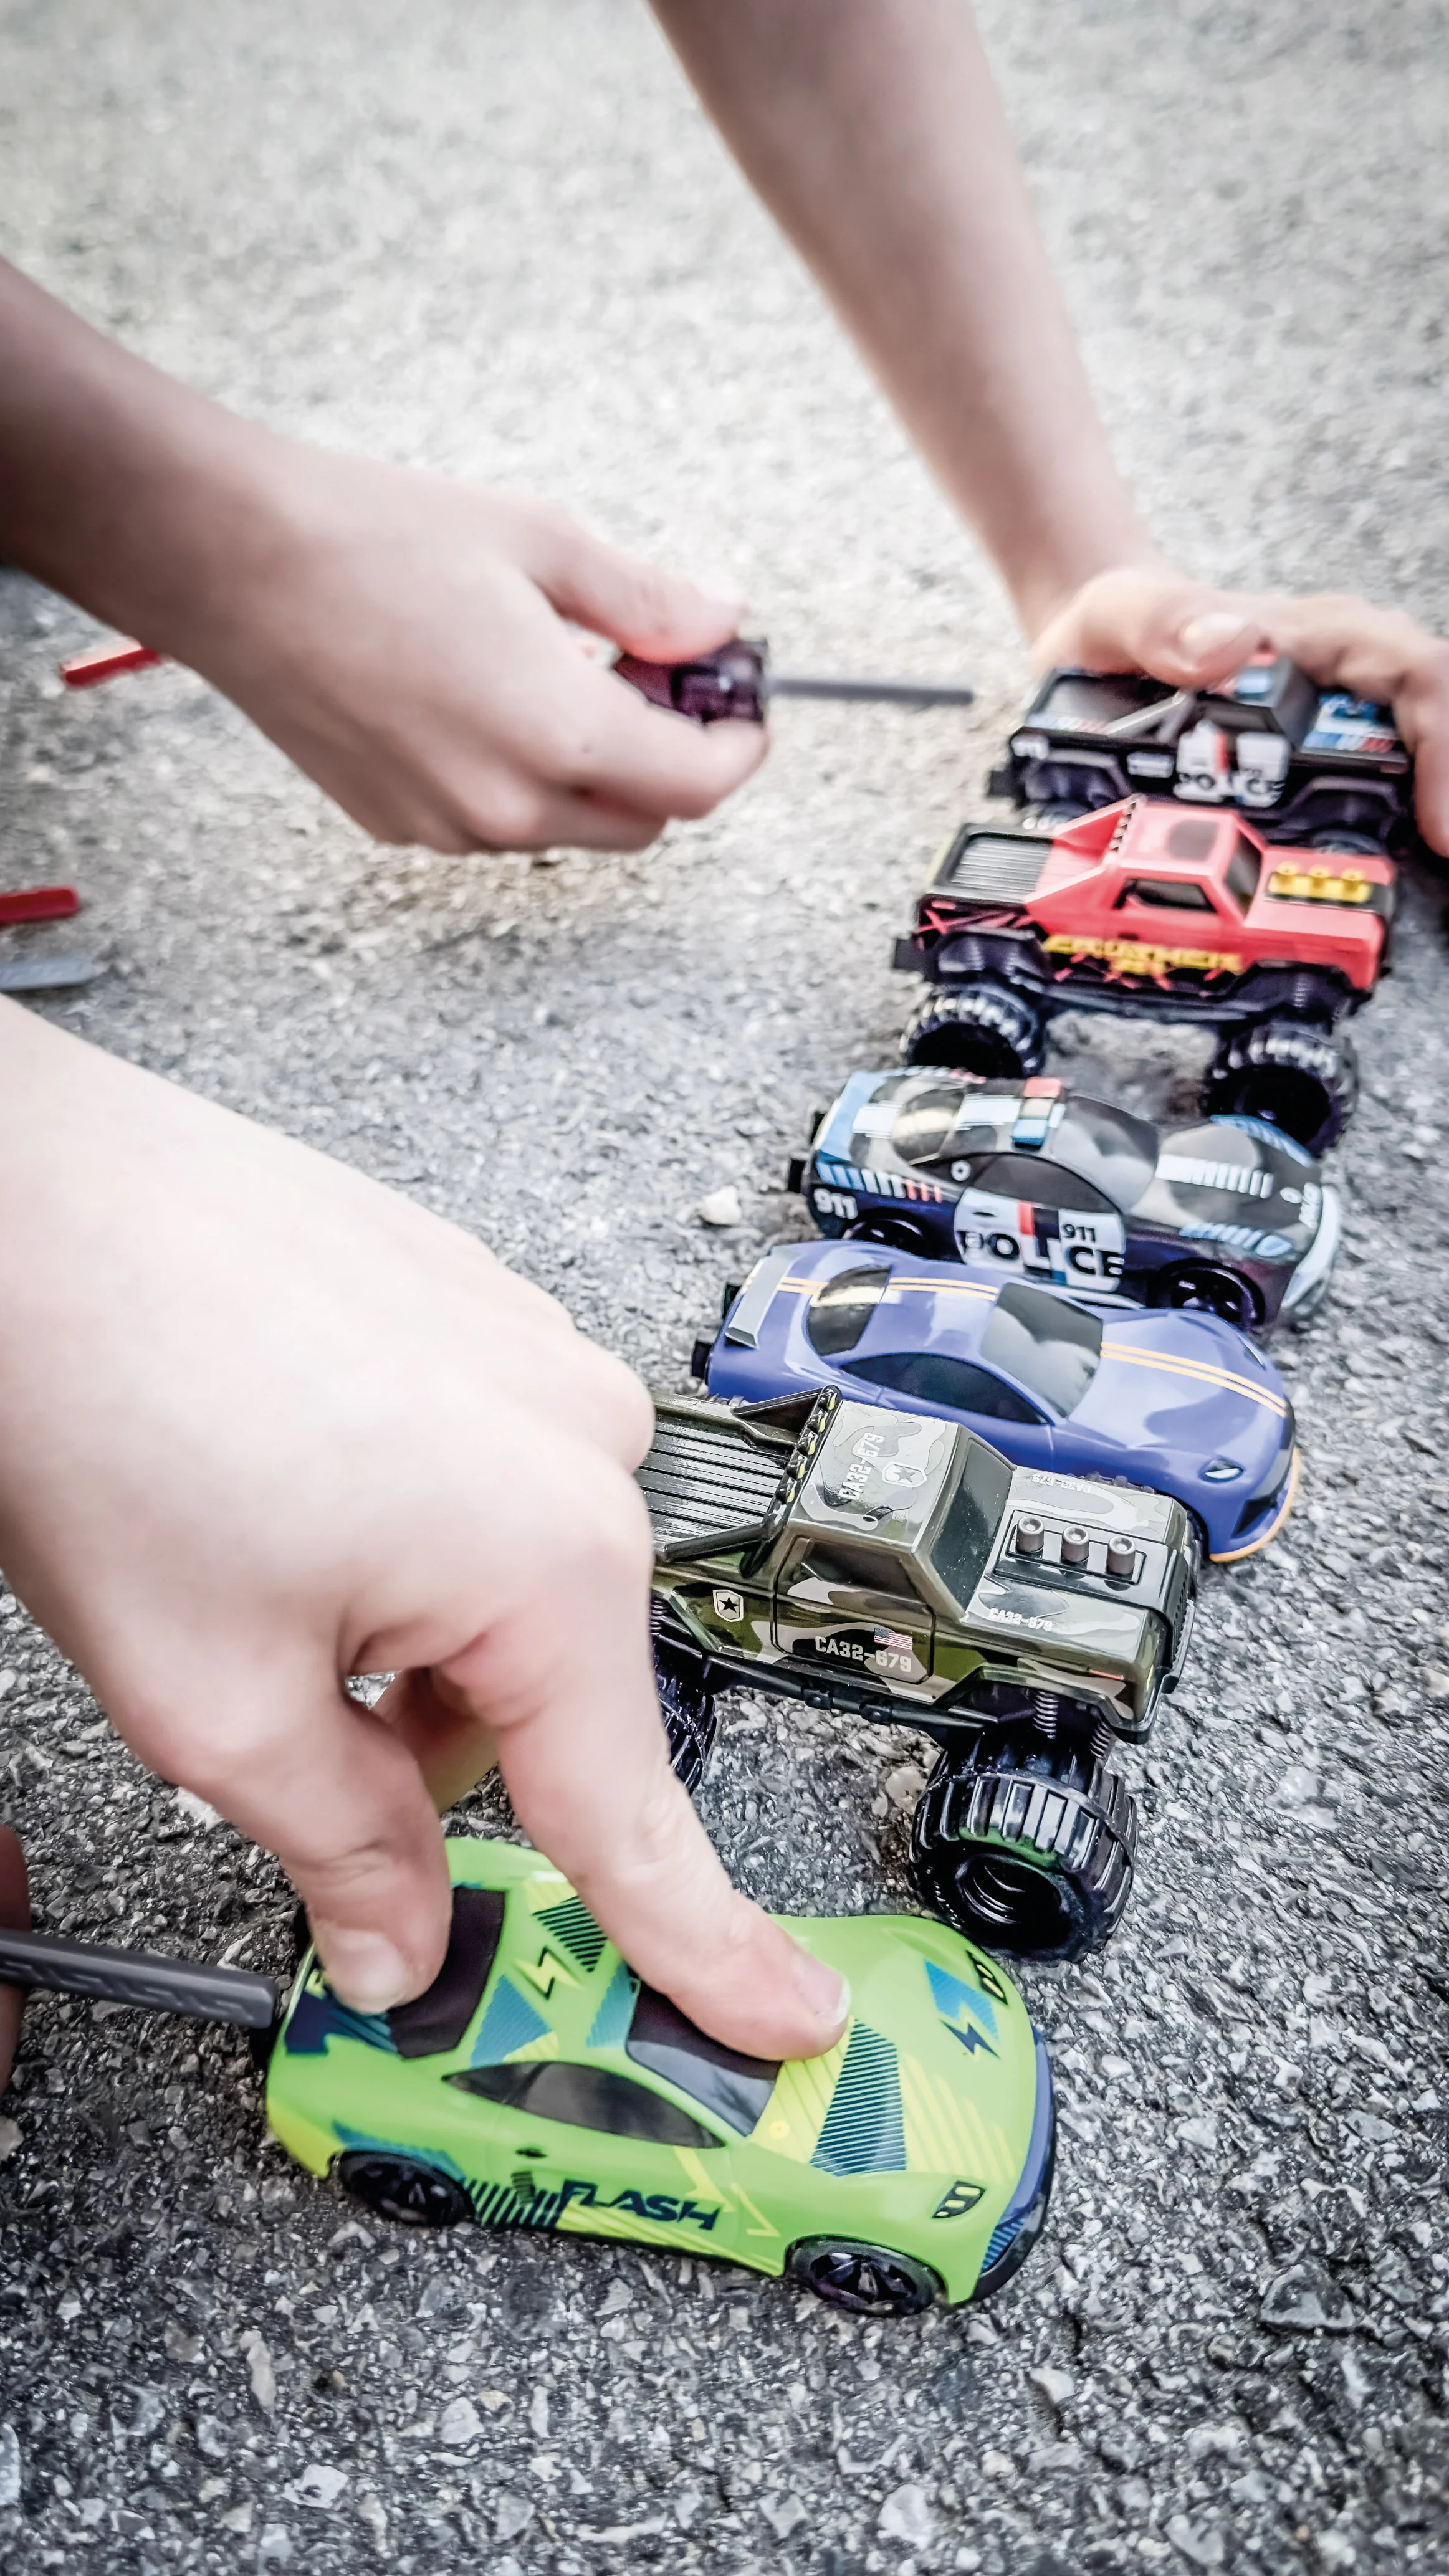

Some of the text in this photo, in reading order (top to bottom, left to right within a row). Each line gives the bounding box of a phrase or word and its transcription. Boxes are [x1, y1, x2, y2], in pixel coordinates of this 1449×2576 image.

[814, 1188, 858, 1219] 911
[957, 1230, 1124, 1280] POLICE
[1063, 1224, 1096, 1243] 911
[838, 1432, 884, 1500] CA32-679
[815, 1636, 911, 1672] CA32-679
[555, 2178, 722, 2231] FLASH
